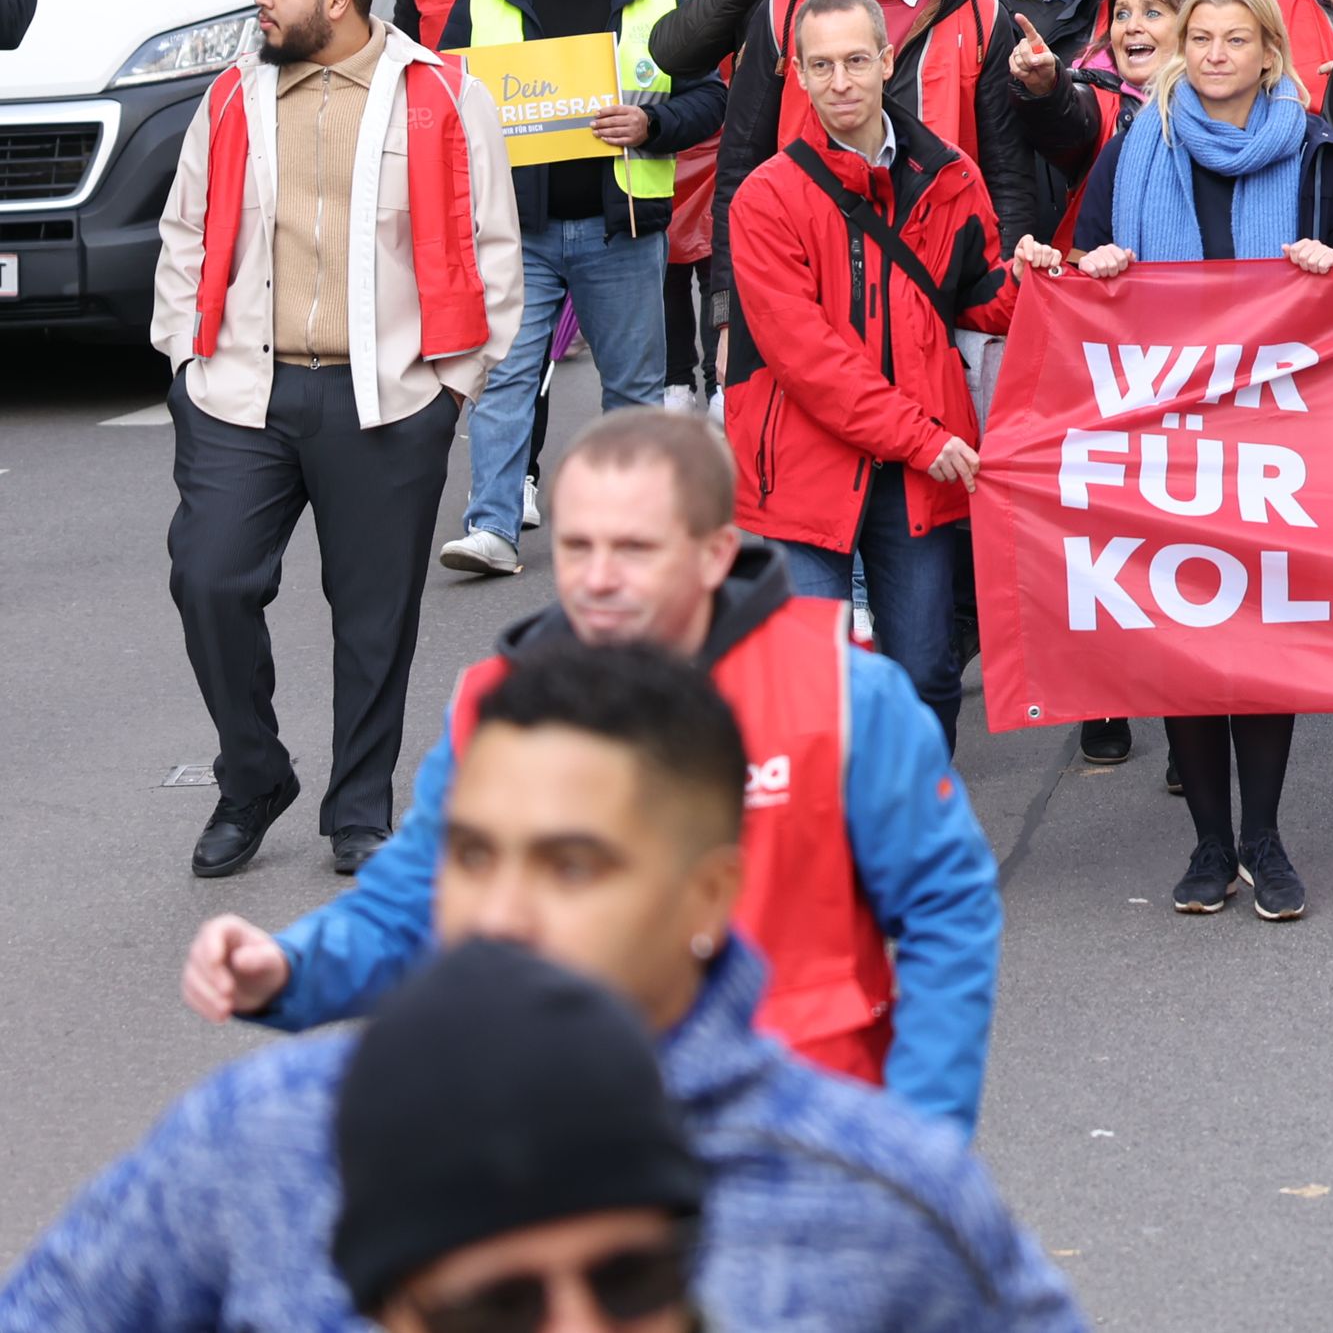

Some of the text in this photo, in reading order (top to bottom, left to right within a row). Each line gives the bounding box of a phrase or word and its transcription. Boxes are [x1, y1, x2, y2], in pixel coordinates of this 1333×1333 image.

[501, 73, 559, 102] Dein
[496, 94, 615, 123] RIEBSRAT
[515, 124, 527, 135] FÜR
[528, 123, 544, 134] DICH
[1083, 341, 1320, 419] WIR
[1058, 412, 1318, 529] FÜR
